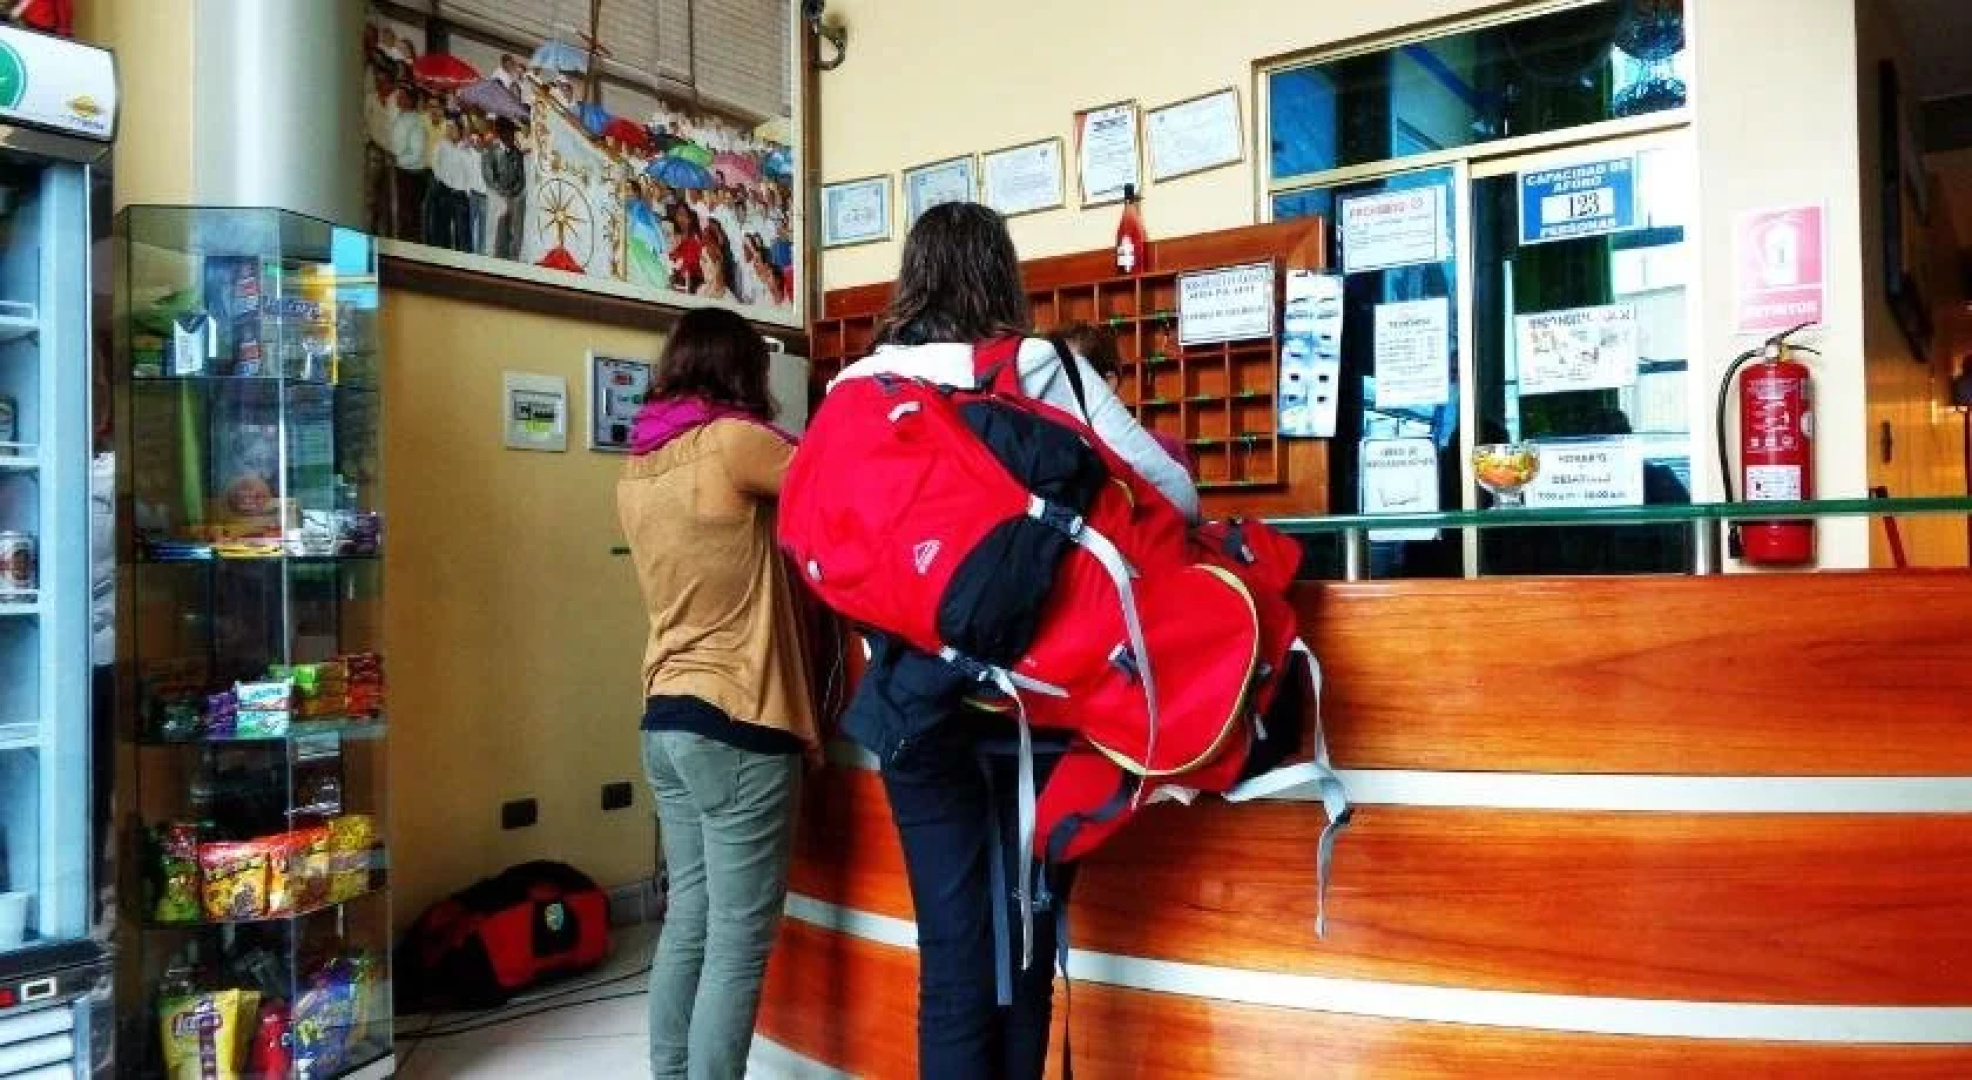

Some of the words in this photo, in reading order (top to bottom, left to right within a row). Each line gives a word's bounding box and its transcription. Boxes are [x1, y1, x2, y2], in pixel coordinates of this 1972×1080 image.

[1525, 163, 1607, 185] CAPACIDAD
[1609, 160, 1629, 172] DE
[1569, 193, 1600, 217] 123
